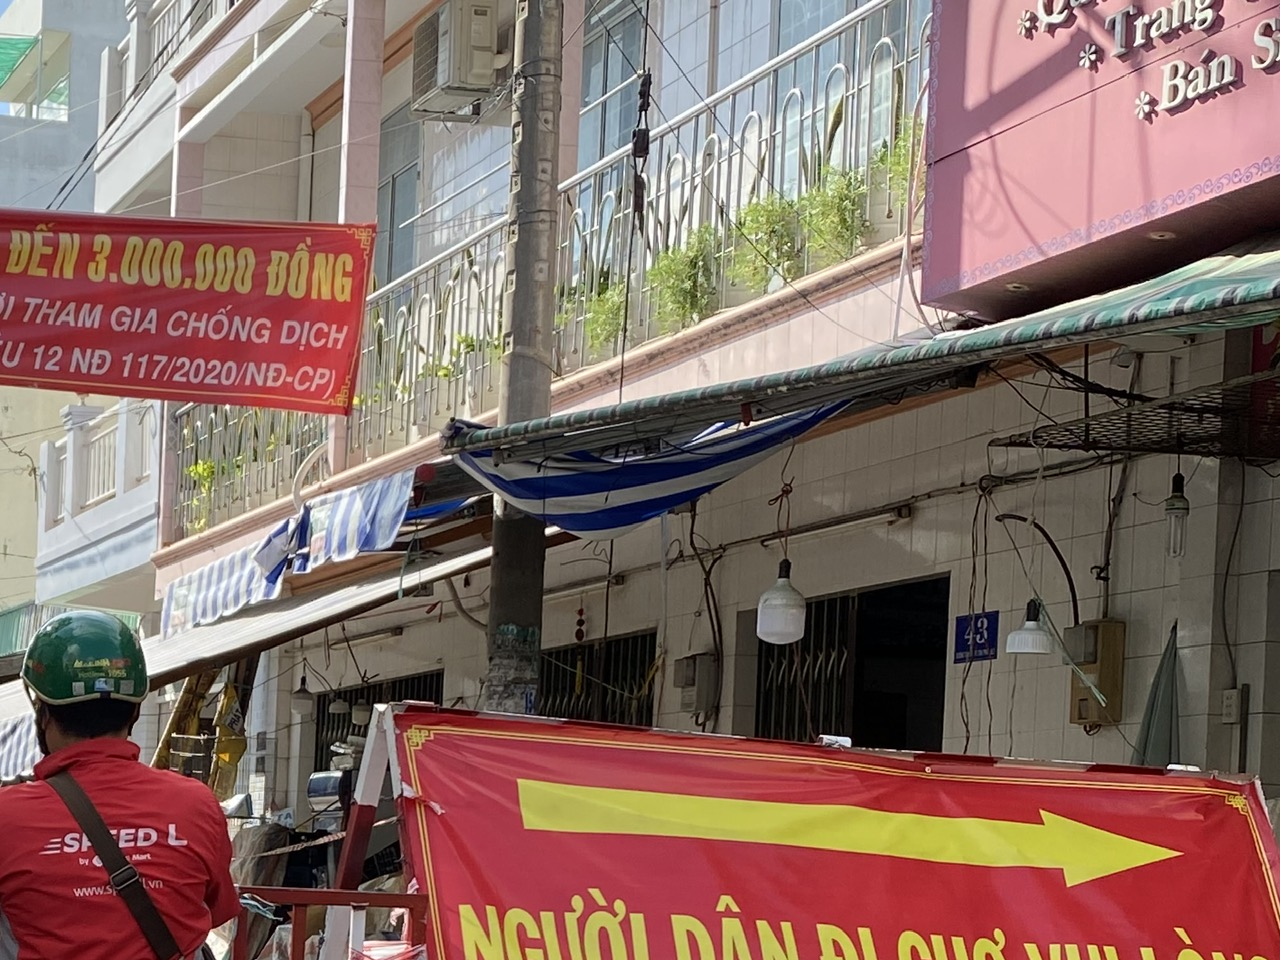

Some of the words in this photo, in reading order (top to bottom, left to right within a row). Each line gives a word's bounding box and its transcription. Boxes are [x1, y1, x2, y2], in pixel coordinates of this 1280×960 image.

[1105, 0, 1215, 58] Trang
[1157, 48, 1238, 111] Bán
[6, 223, 80, 280] ĐẾN
[88, 233, 256, 294] 3.000.000
[265, 236, 354, 302] ĐỒNG
[23, 296, 104, 329] THAM
[110, 305, 158, 335] GIA
[166, 304, 272, 344] CHỐNG
[280, 319, 350, 351] DỊCH
[33, 345, 62, 373] 12
[70, 346, 112, 377] NĐ
[121, 353, 337, 400] 117/2020/NĐ-CP)
[964, 617, 988, 645] 43
[62, 827, 158, 853] SPED
[167, 823, 188, 847] L
